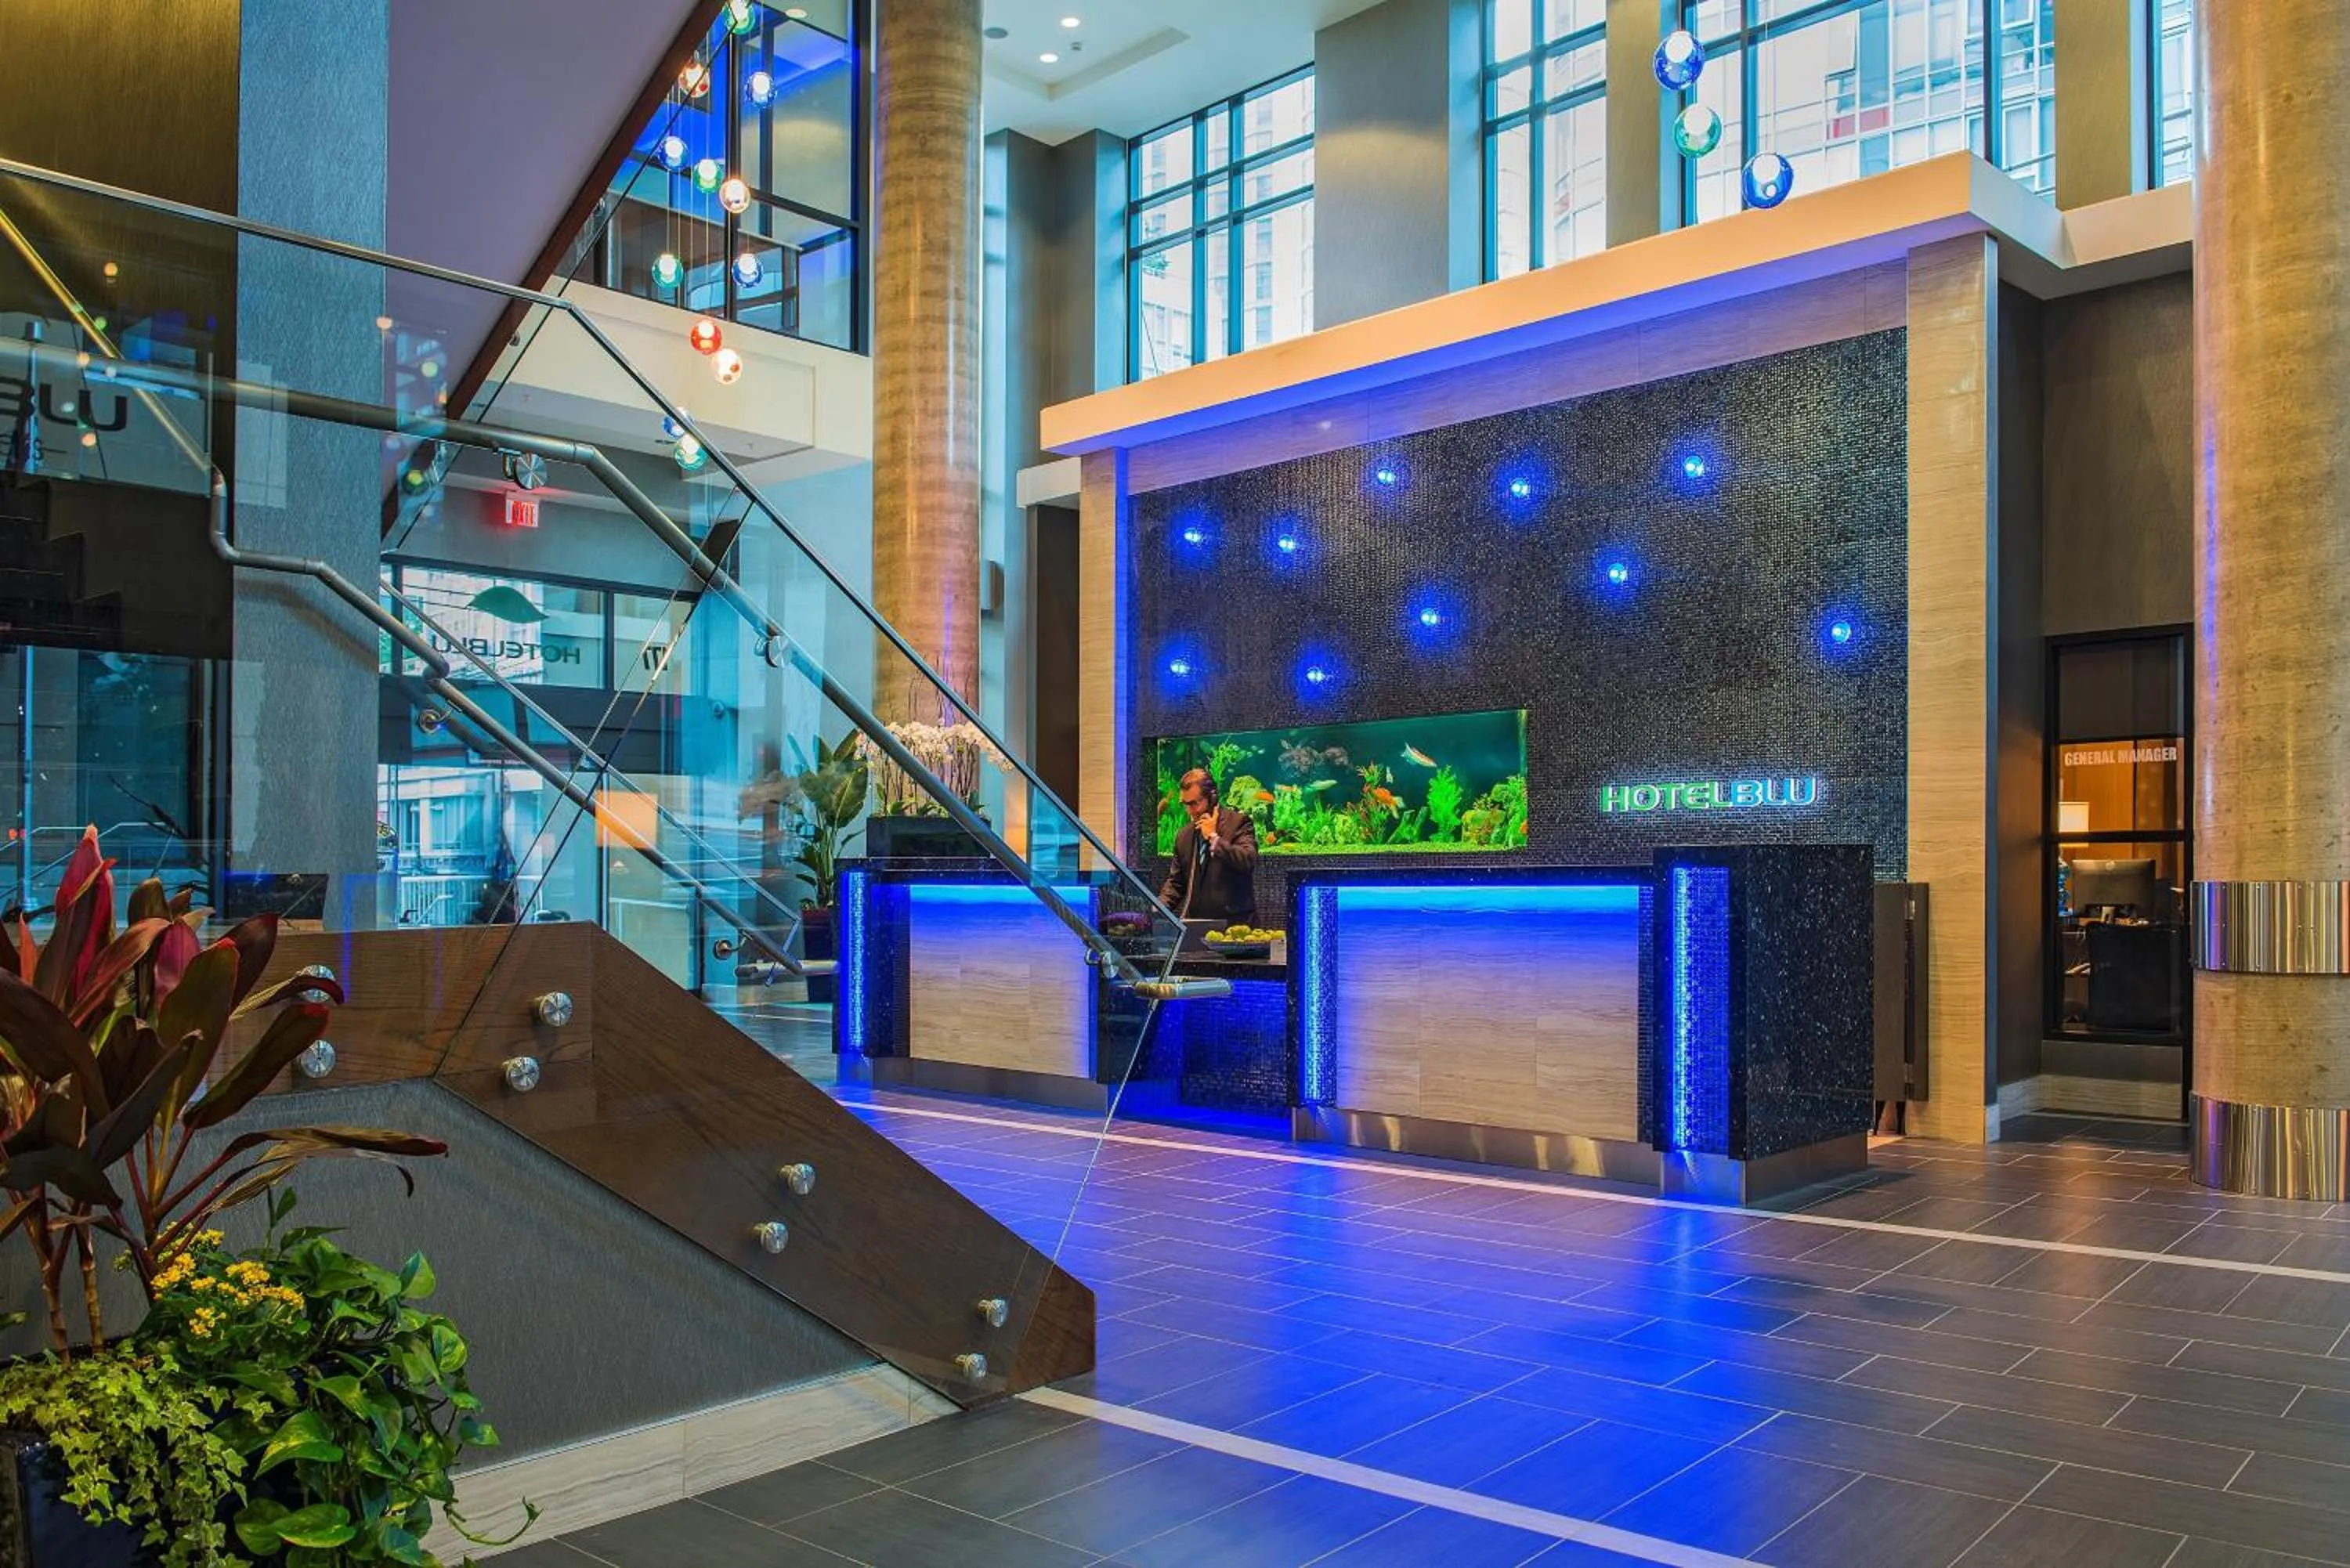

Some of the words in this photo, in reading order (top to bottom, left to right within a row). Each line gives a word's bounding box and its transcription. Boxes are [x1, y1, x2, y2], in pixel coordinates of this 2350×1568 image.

[2064, 750, 2115, 767] GENERAL
[2117, 746, 2178, 764] MANAGER
[1602, 778, 1817, 812] HOTELBLU
